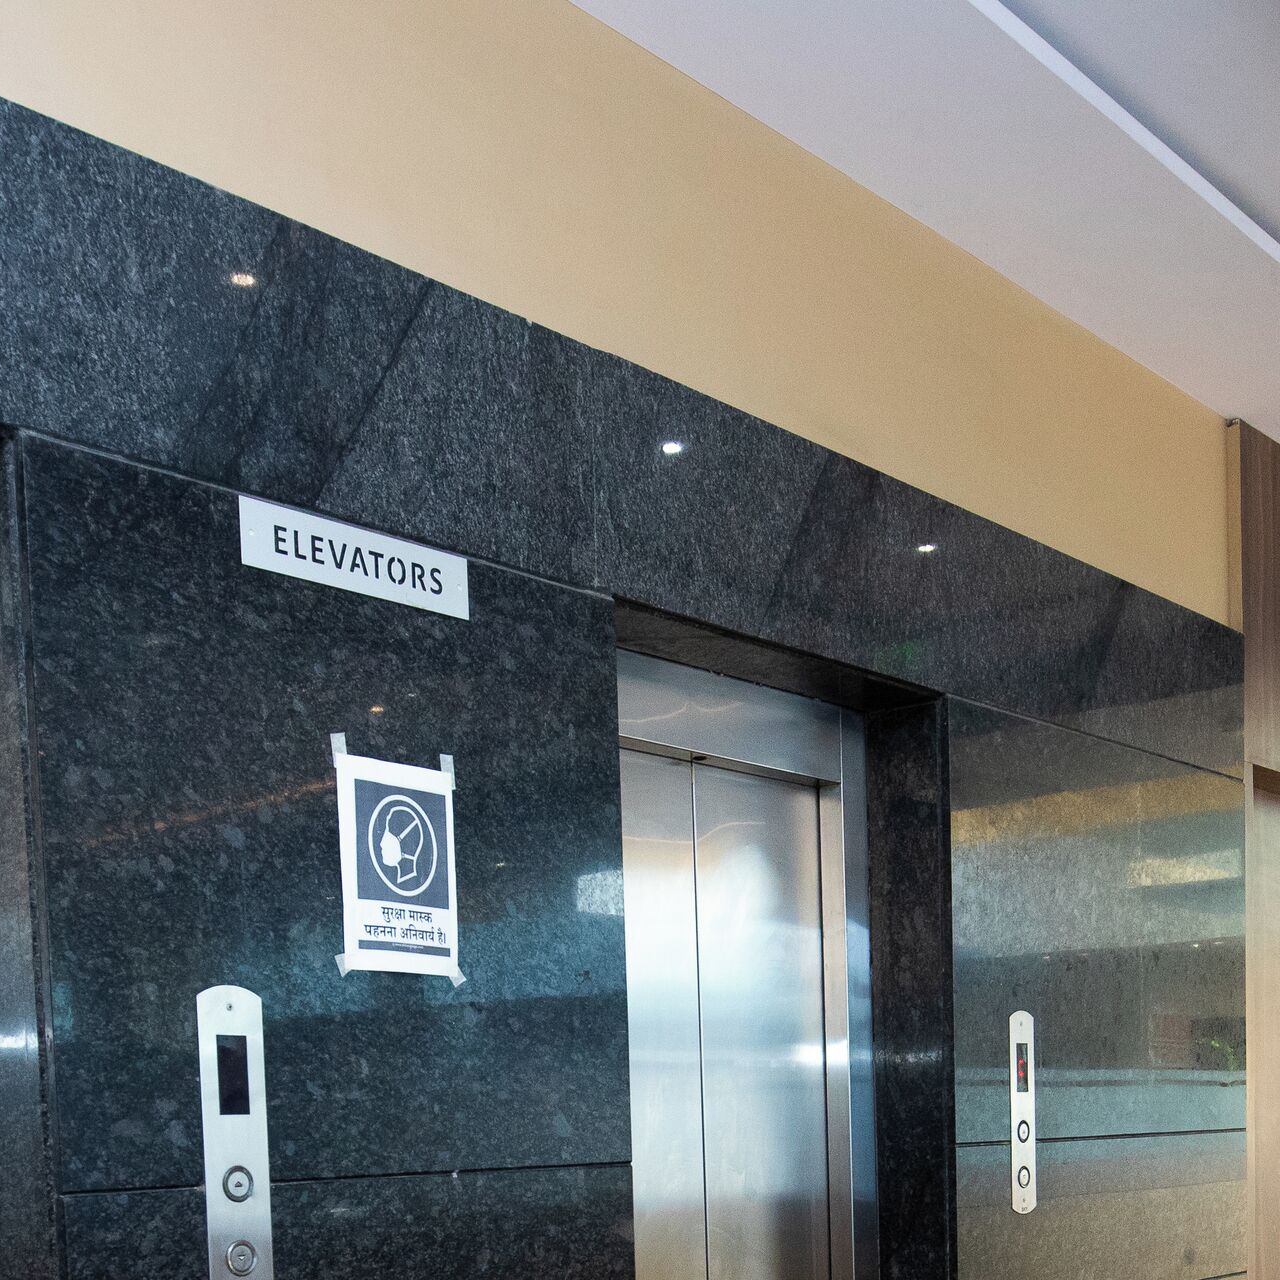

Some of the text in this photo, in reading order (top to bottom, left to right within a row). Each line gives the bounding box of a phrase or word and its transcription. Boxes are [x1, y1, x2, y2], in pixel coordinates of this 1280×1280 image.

[274, 525, 443, 595] ELEVATORS
[381, 907, 433, 923] सुरक्षा मास्क
[364, 924, 397, 938] पहनना
[400, 924, 435, 942] अनिवार्य
